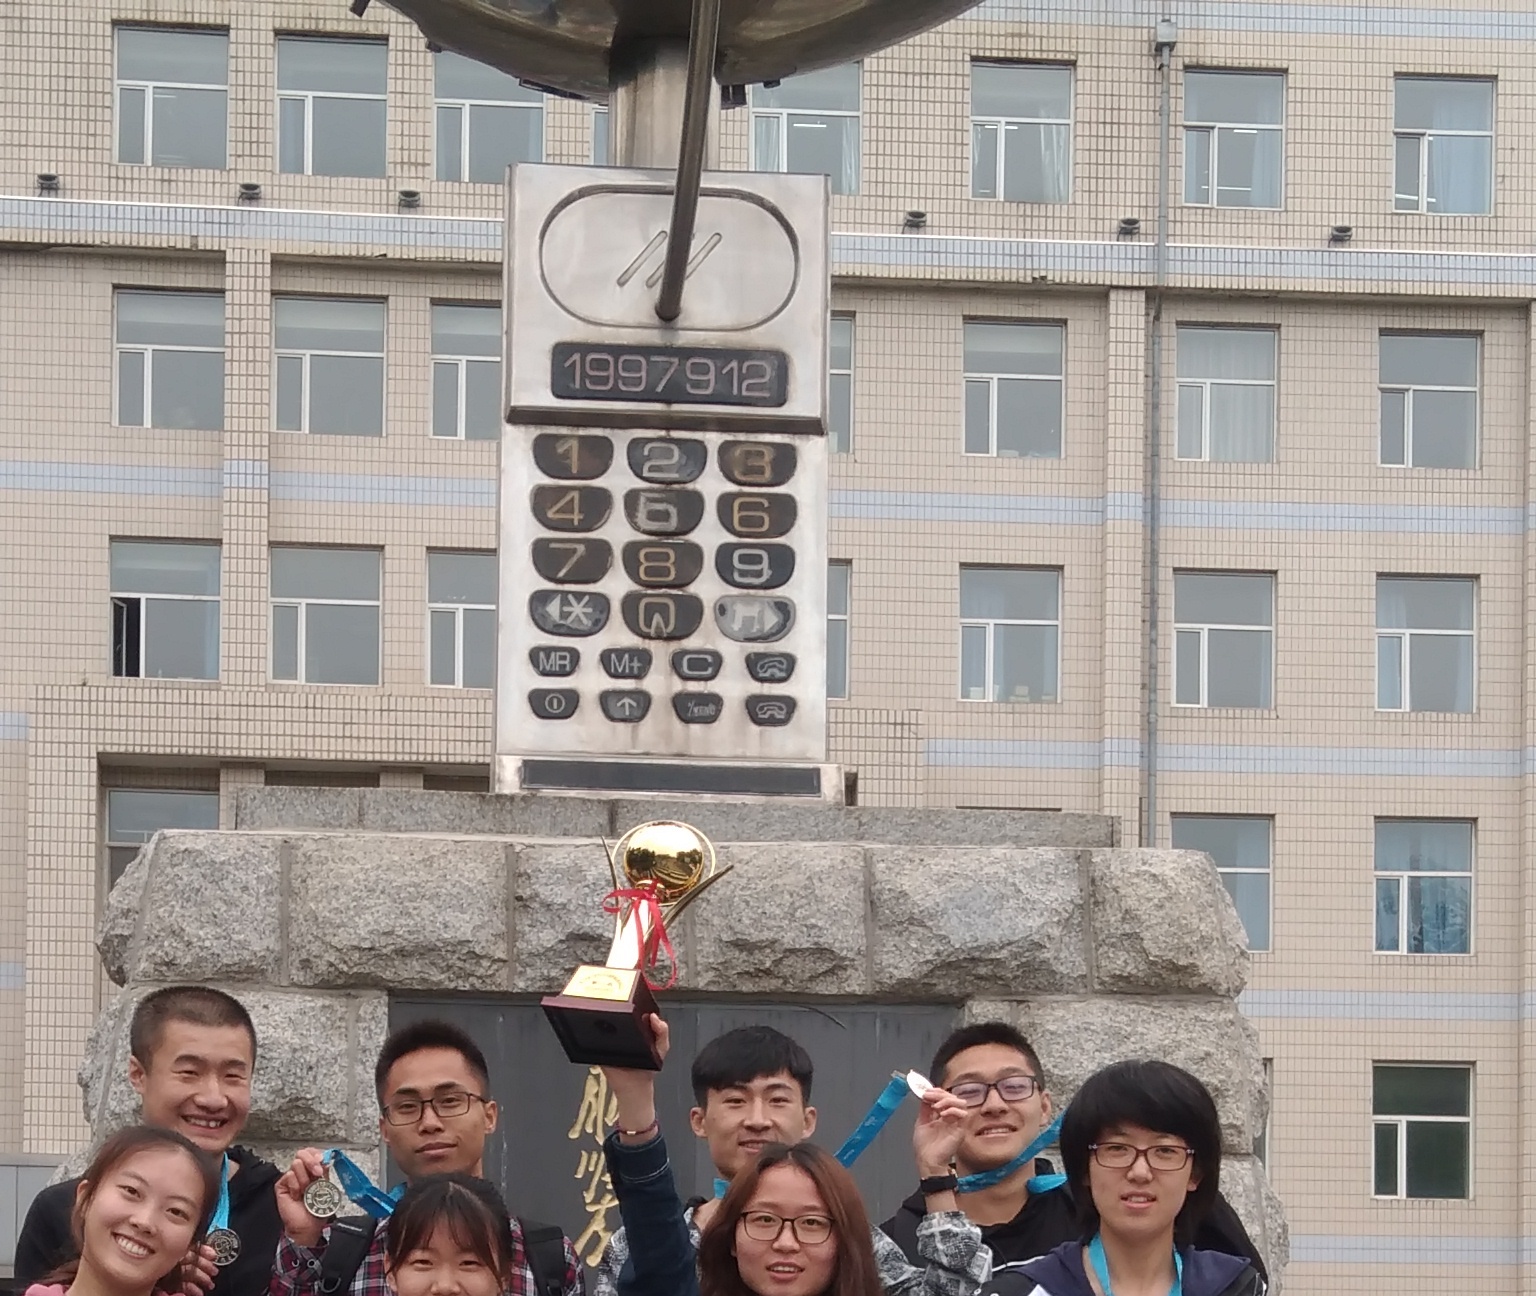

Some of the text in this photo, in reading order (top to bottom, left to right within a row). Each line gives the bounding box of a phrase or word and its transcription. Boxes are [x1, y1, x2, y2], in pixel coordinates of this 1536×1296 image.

[564, 352, 772, 398] 1997912
[555, 437, 580, 475] 1
[642, 441, 681, 479] 2
[546, 489, 585, 527] 4
[732, 496, 770, 533] 6
[548, 542, 773, 584] 7 8 9
[538, 651, 714, 676] MR M+ C
